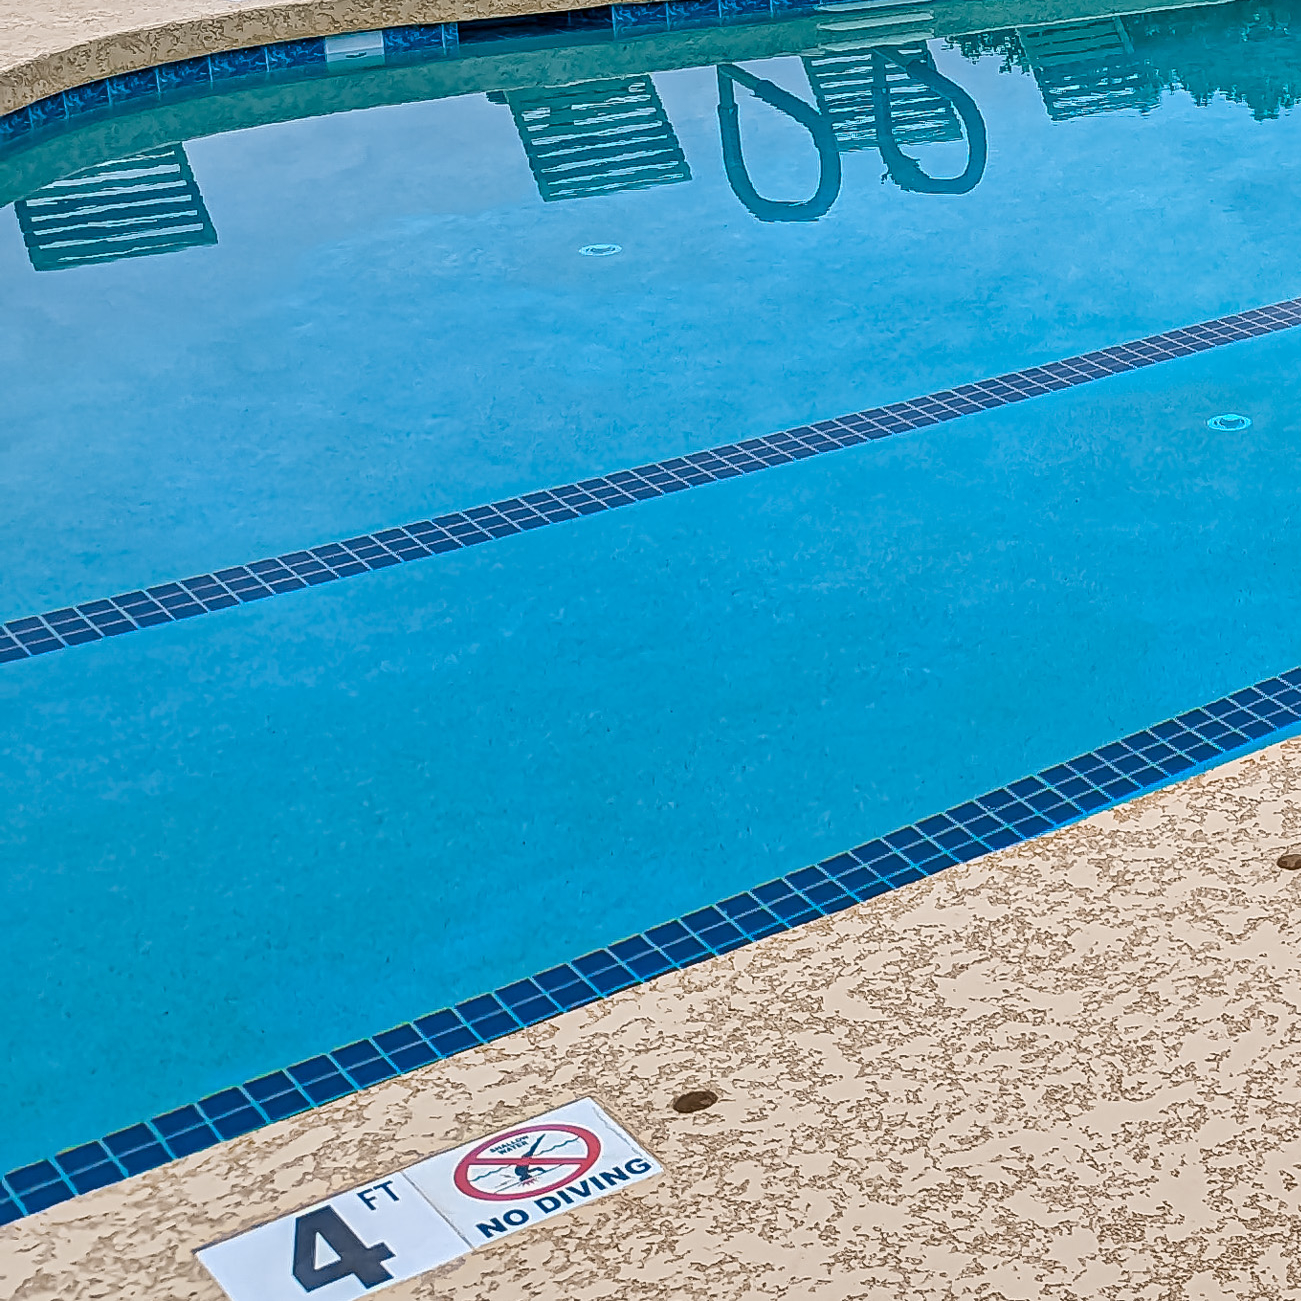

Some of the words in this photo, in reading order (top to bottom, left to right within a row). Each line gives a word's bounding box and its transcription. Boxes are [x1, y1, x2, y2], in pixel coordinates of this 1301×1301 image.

[489, 1135, 529, 1153] SHALLOW
[497, 1140, 529, 1155] WATER
[475, 1208, 530, 1239] NO
[533, 1157, 652, 1214] DIVING
[293, 1204, 397, 1293] 4
[356, 1180, 400, 1211] FT
